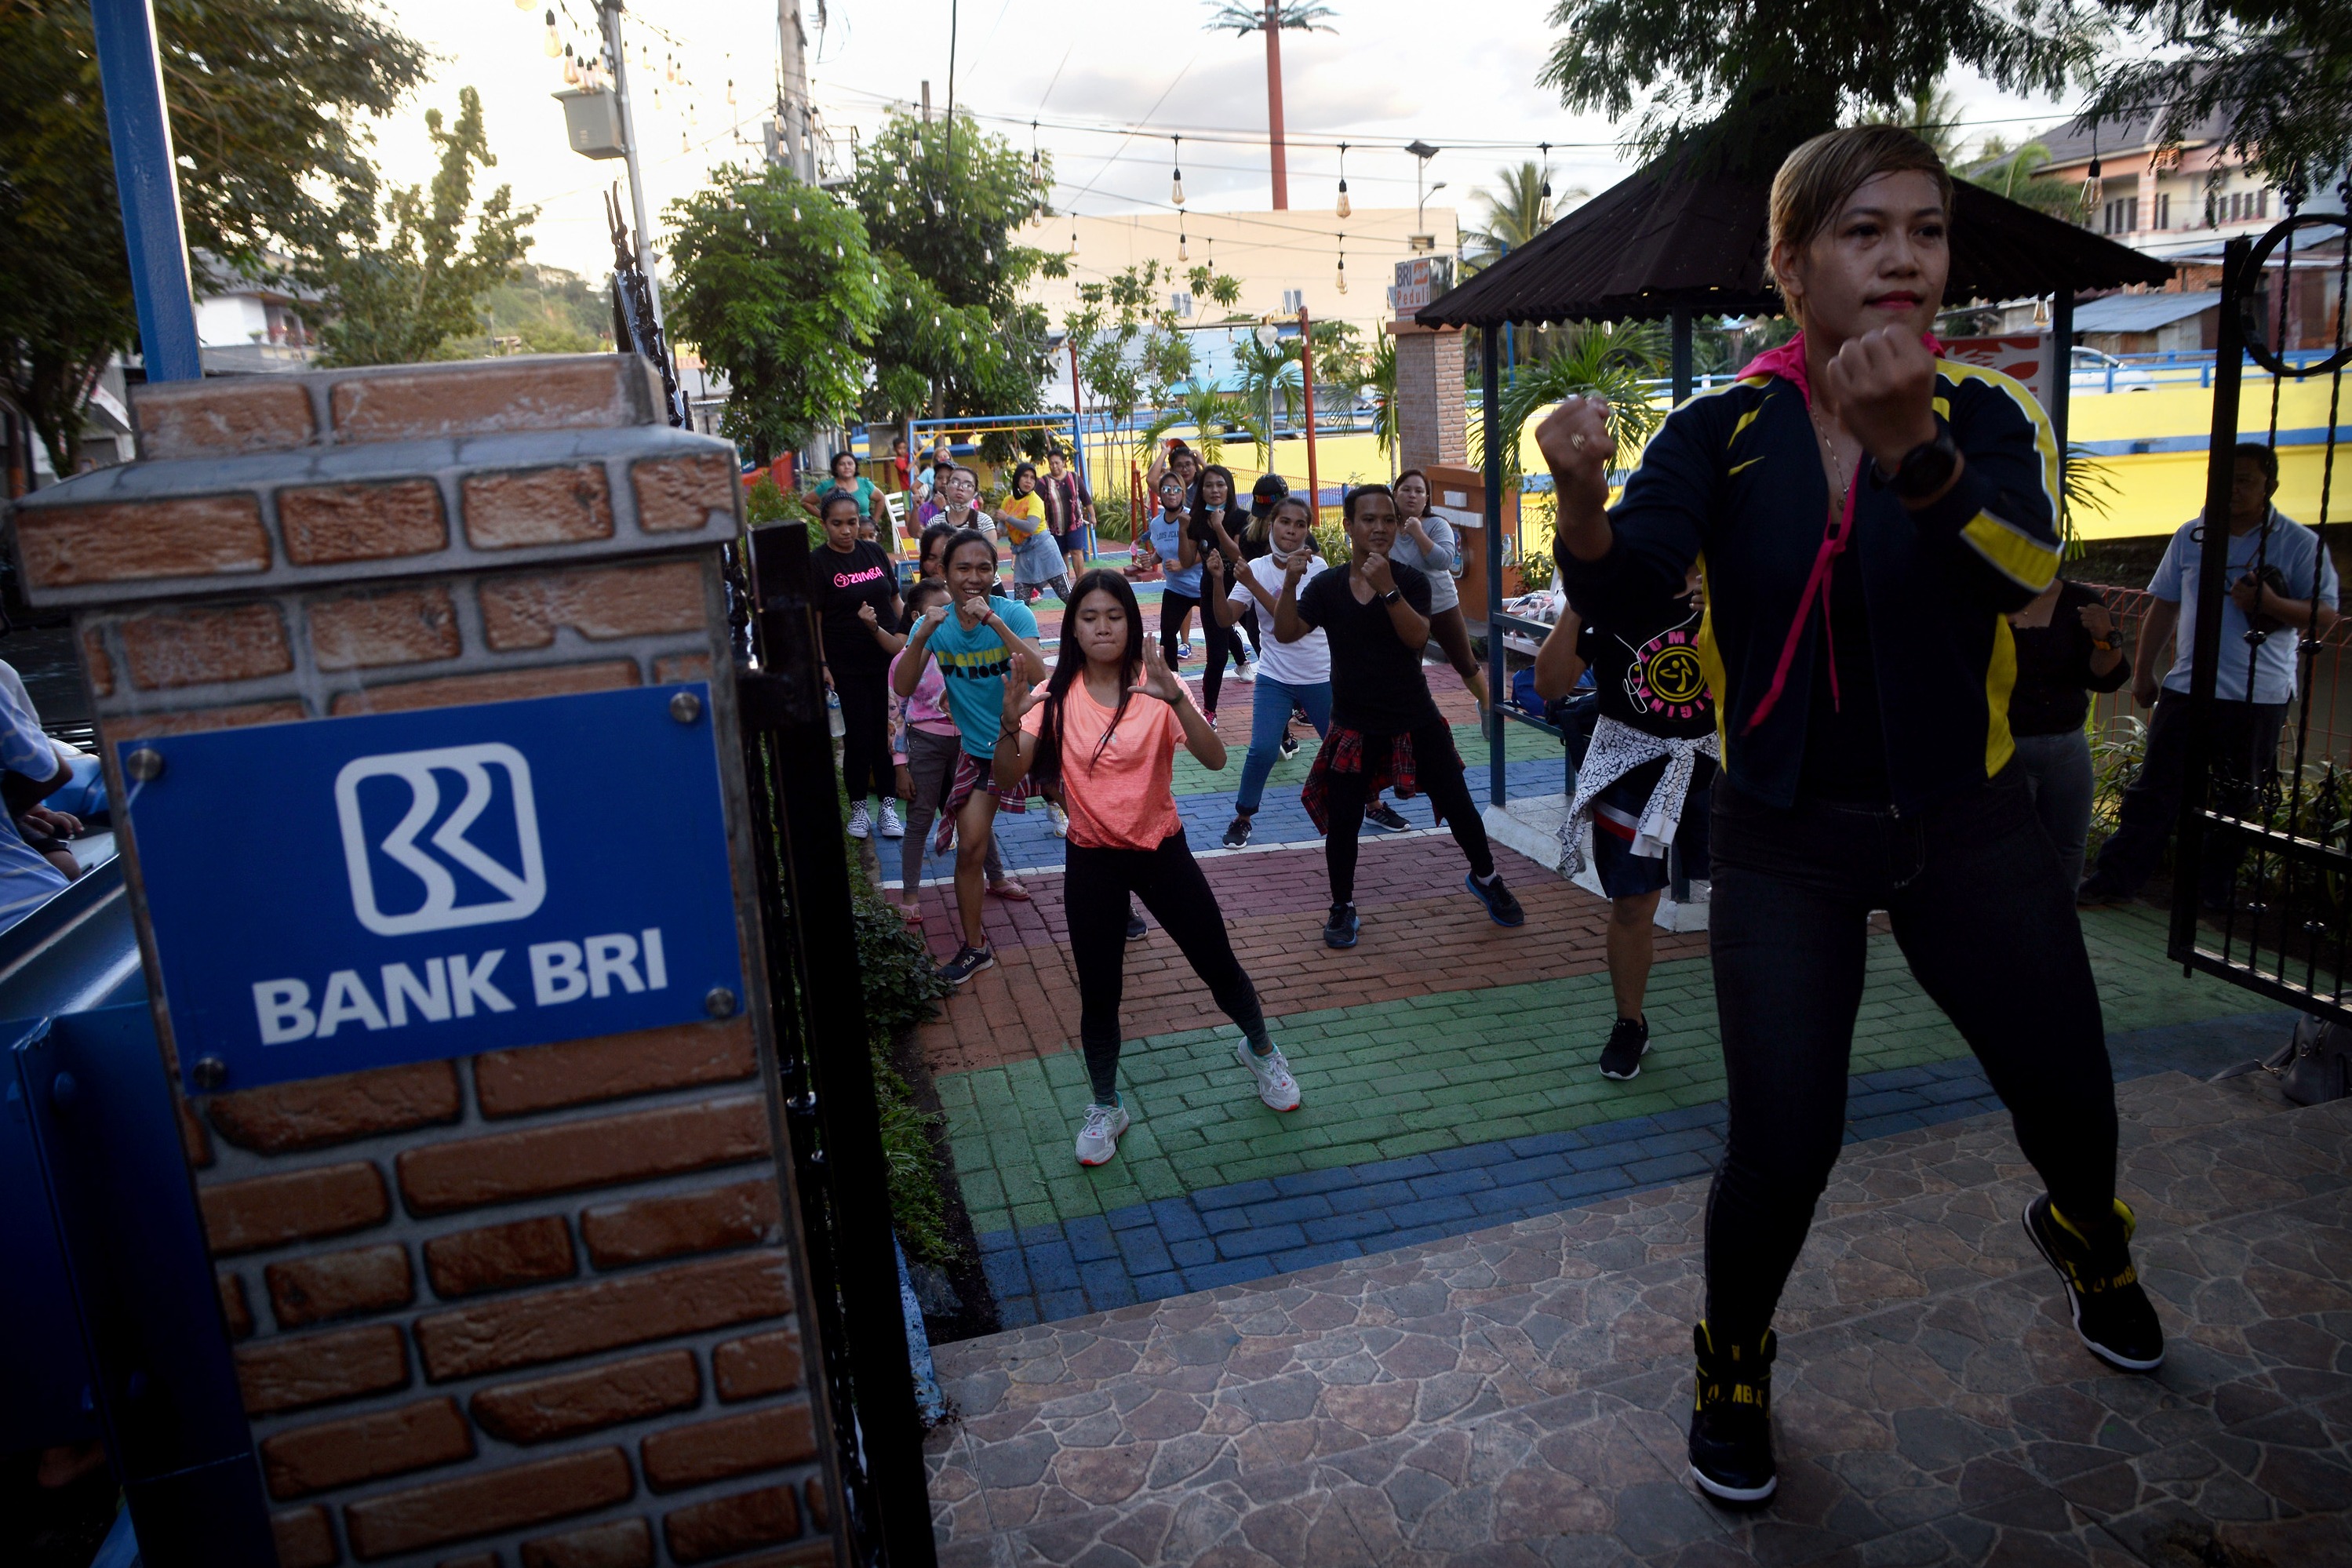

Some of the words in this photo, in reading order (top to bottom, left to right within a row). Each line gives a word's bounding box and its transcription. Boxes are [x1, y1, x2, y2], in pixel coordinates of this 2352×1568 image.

[1397, 264, 1411, 287] BRI
[1397, 286, 1429, 305] Peduli
[847, 566, 884, 583] ZUMBA
[940, 664, 963, 678] WE
[968, 658, 1011, 679] ROCK
[961, 955, 975, 969] FILA
[253, 948, 516, 1046] BANK
[528, 927, 668, 1007] BRI
